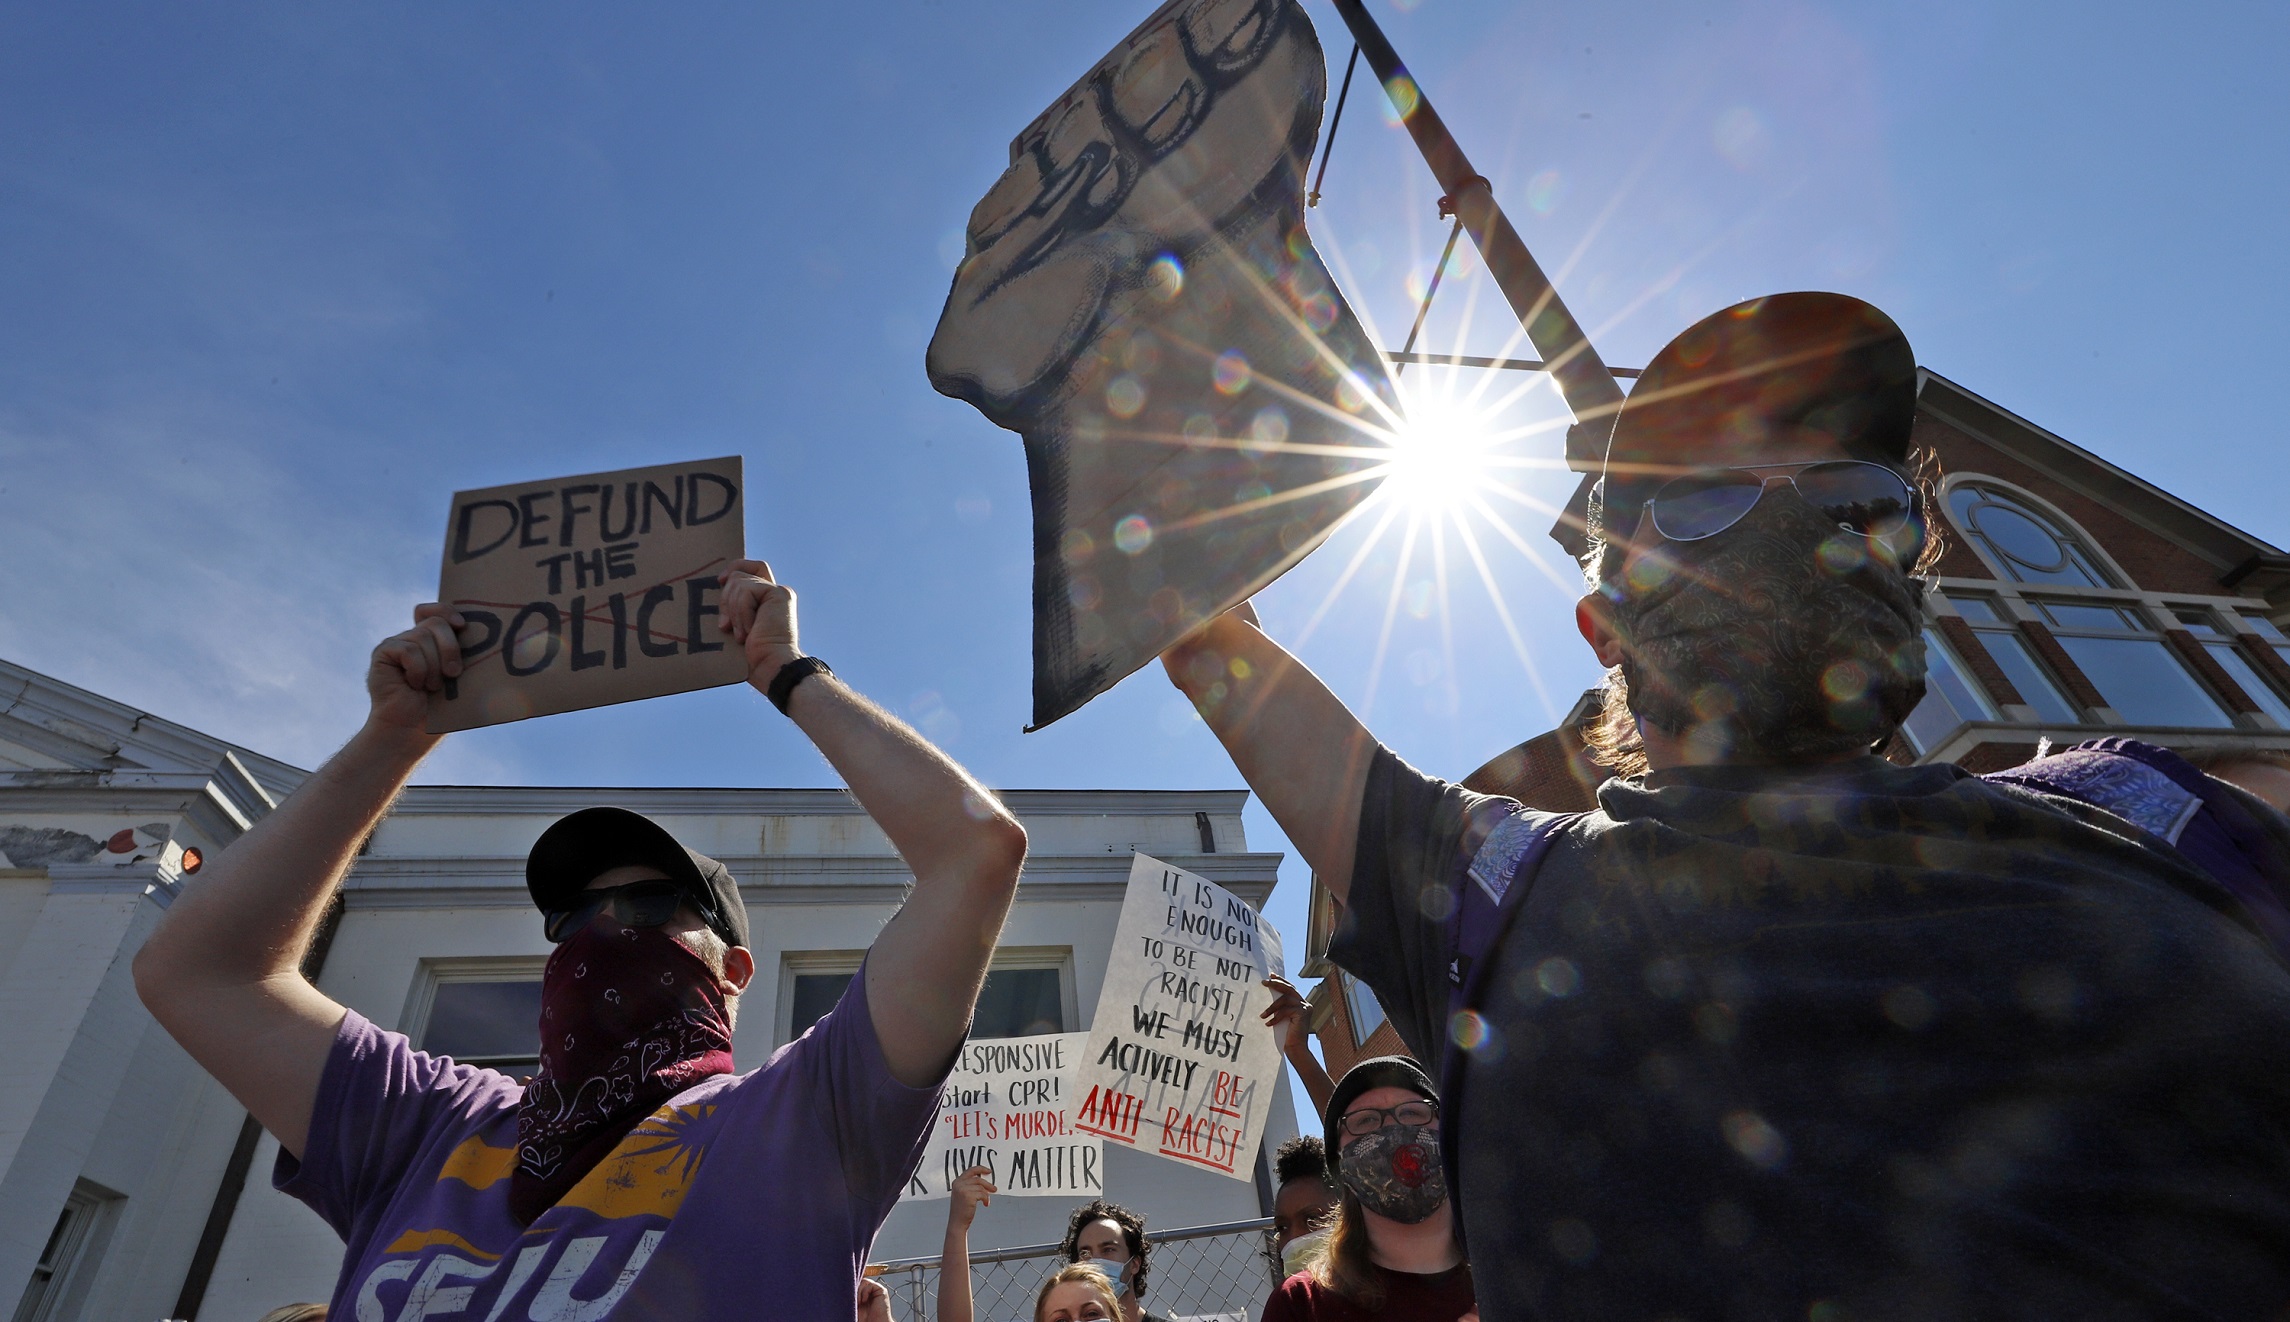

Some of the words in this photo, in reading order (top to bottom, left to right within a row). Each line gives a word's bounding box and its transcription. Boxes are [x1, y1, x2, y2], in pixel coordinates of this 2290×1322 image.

[453, 472, 738, 565] DEFUND
[536, 542, 639, 595] THE
[445, 576, 724, 700] POLICE
[1162, 870, 1182, 896] IT
[1195, 882, 1213, 909] IS
[1227, 898, 1259, 932] NOT
[1167, 905, 1252, 951] ENOUGH
[1141, 936, 1163, 959] TO
[1173, 946, 1198, 970] BE
[1216, 957, 1253, 983] NOT
[1160, 971, 1235, 1021] RACIST,
[954, 1038, 1066, 1074] ESPONSIVE
[1133, 1004, 1170, 1039] WE
[1182, 1019, 1245, 1062] MUST
[1008, 1076, 1060, 1107] CPR!
[1097, 1036, 1199, 1091] ACTIVELY
[1214, 1071, 1244, 1107] BE
[1004, 1109, 1074, 1140] MURDE
[1161, 1105, 1242, 1167] RACIST
[1008, 1145, 1102, 1191] MATTER
